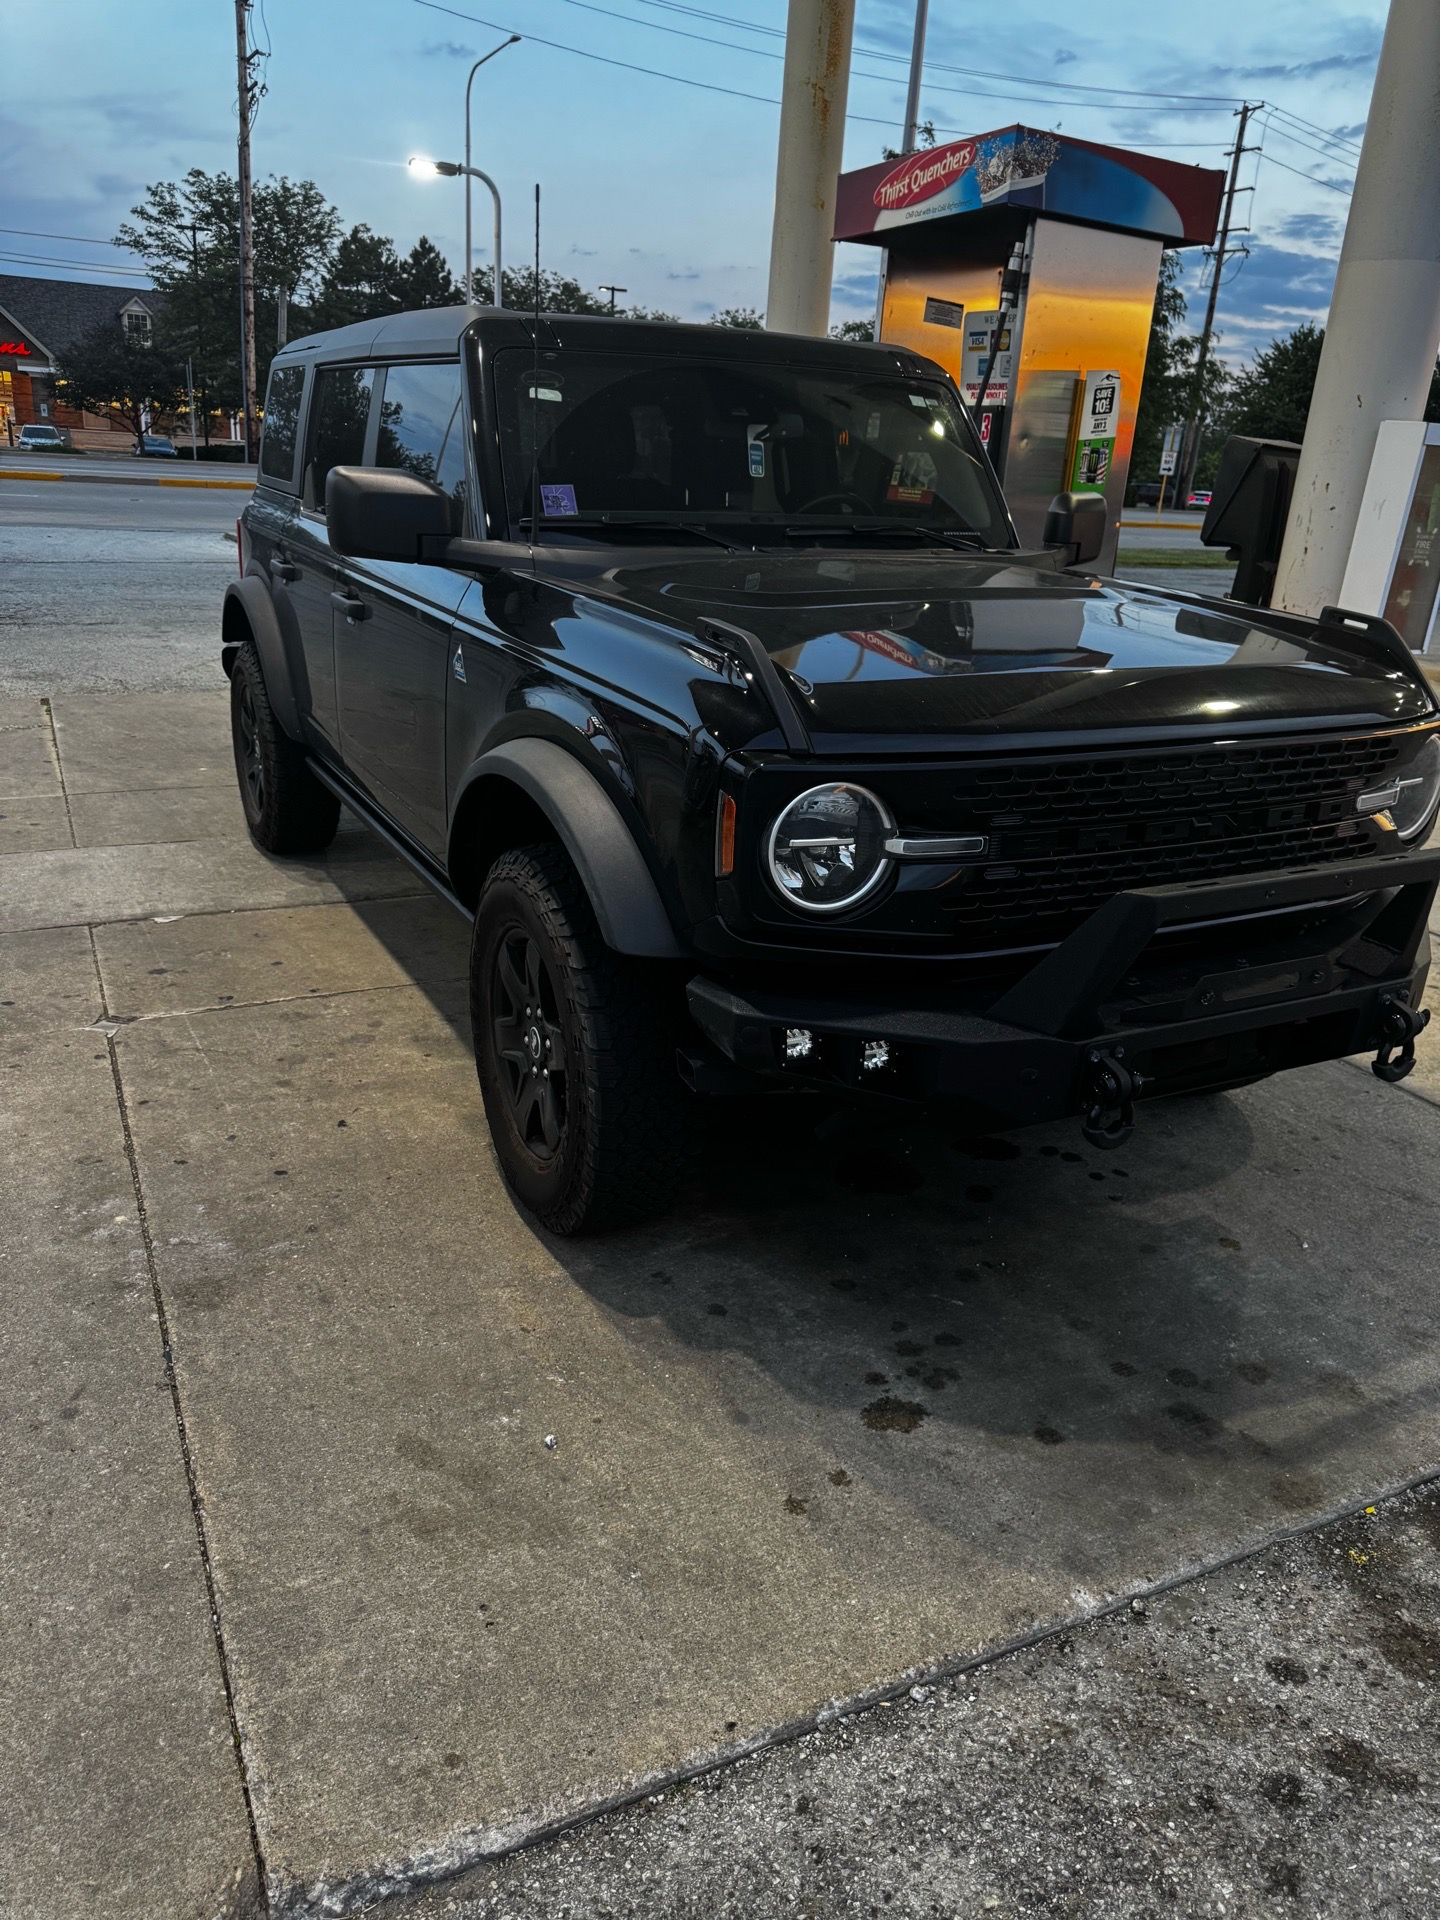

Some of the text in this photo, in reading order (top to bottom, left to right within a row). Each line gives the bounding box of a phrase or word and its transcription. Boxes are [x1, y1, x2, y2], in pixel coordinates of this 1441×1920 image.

[880, 147, 971, 206] Thirst Quenchers
[995, 313, 1017, 324] AEP
[971, 337, 985, 346] VISA
[1095, 388, 1113, 399] SAVE
[981, 414, 991, 441] 3
[1093, 421, 1103, 430] ANY
